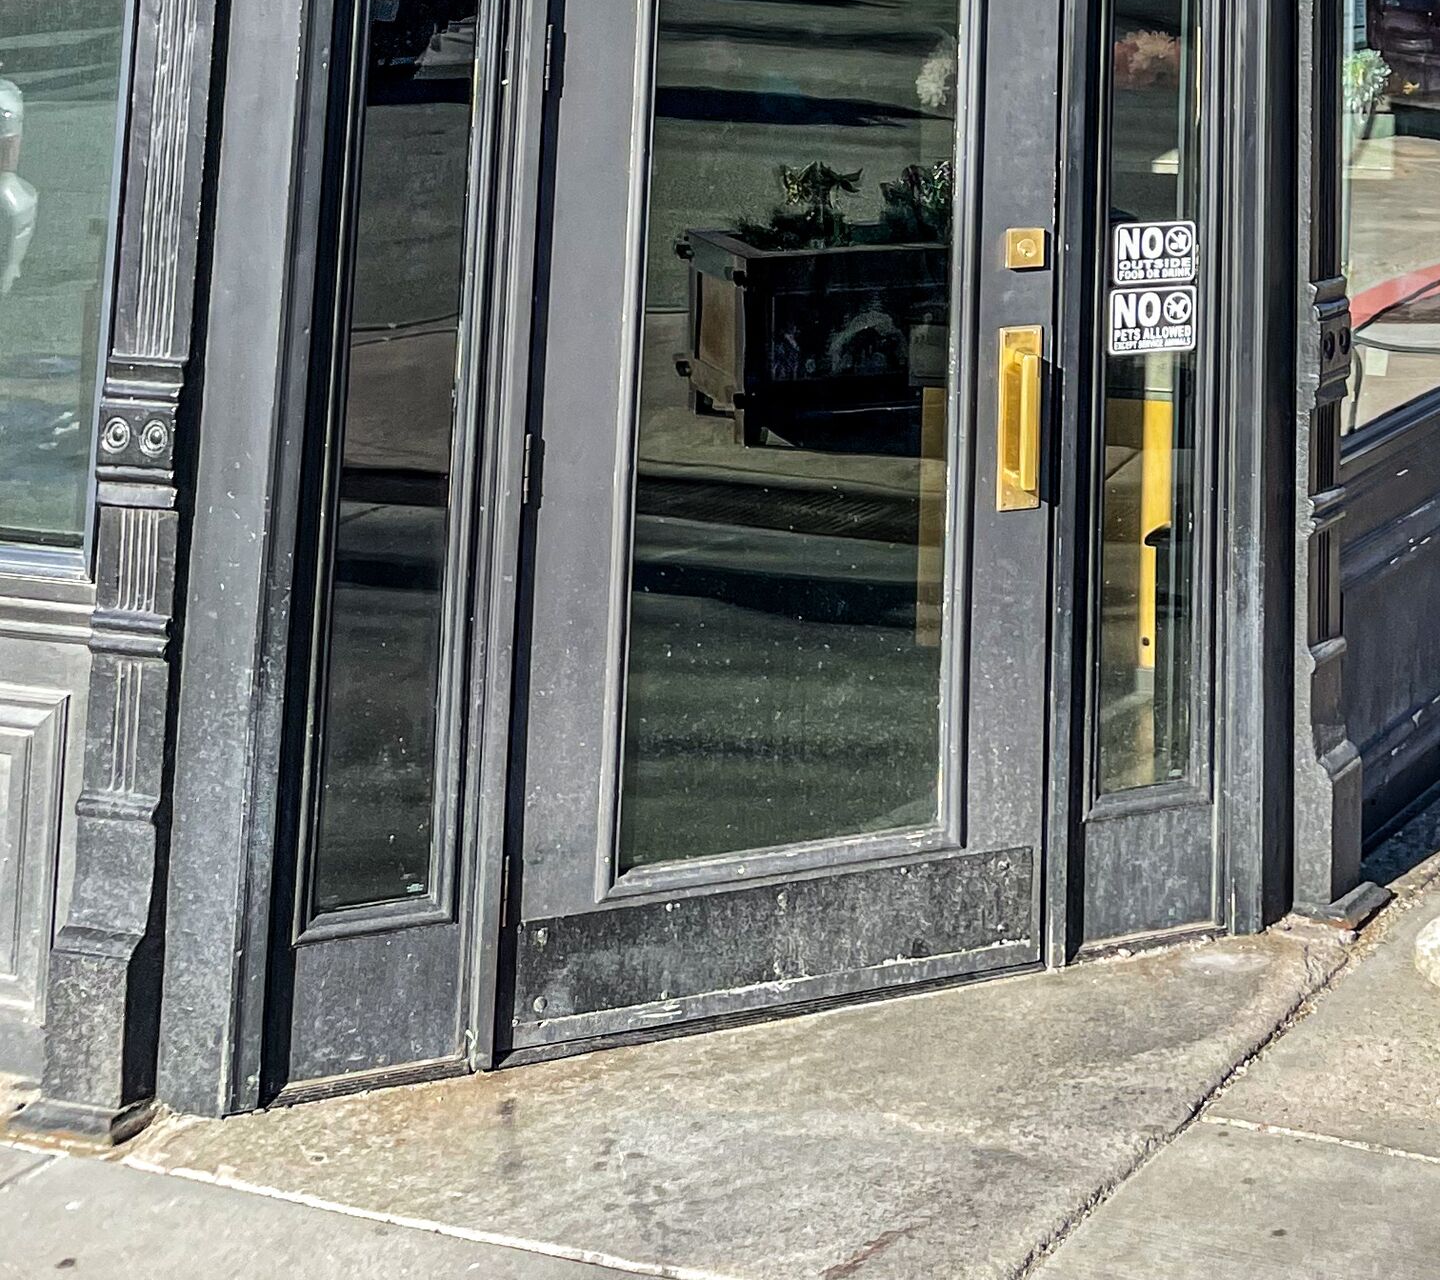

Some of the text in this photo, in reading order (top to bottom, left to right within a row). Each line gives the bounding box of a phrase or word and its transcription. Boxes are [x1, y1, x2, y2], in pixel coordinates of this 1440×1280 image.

[1119, 226, 1164, 260] NO
[1119, 256, 1192, 271] OUTSIDE
[1119, 266, 1191, 280] FOOD OR DRINK
[1114, 291, 1161, 329] NO
[1114, 324, 1192, 342] PETS ALLOWED
